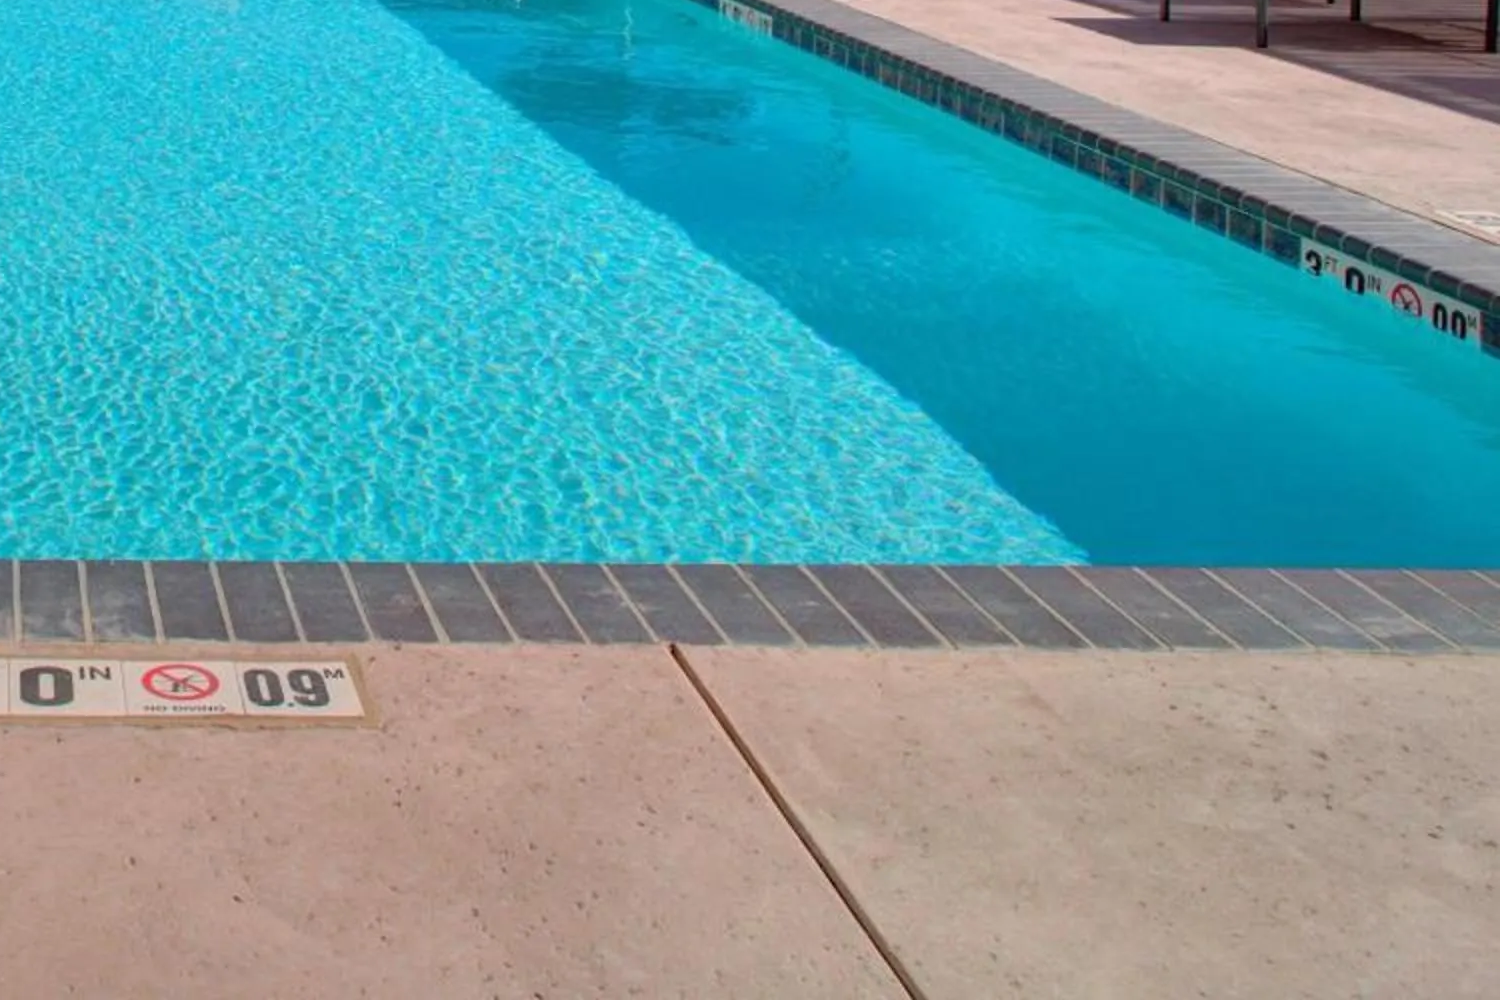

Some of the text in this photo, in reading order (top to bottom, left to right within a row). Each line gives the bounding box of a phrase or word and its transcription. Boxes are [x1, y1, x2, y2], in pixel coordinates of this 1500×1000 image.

[19, 666, 74, 707] 0
[79, 665, 112, 680] IN
[243, 668, 331, 708] 0.9
[322, 667, 345, 680] M
